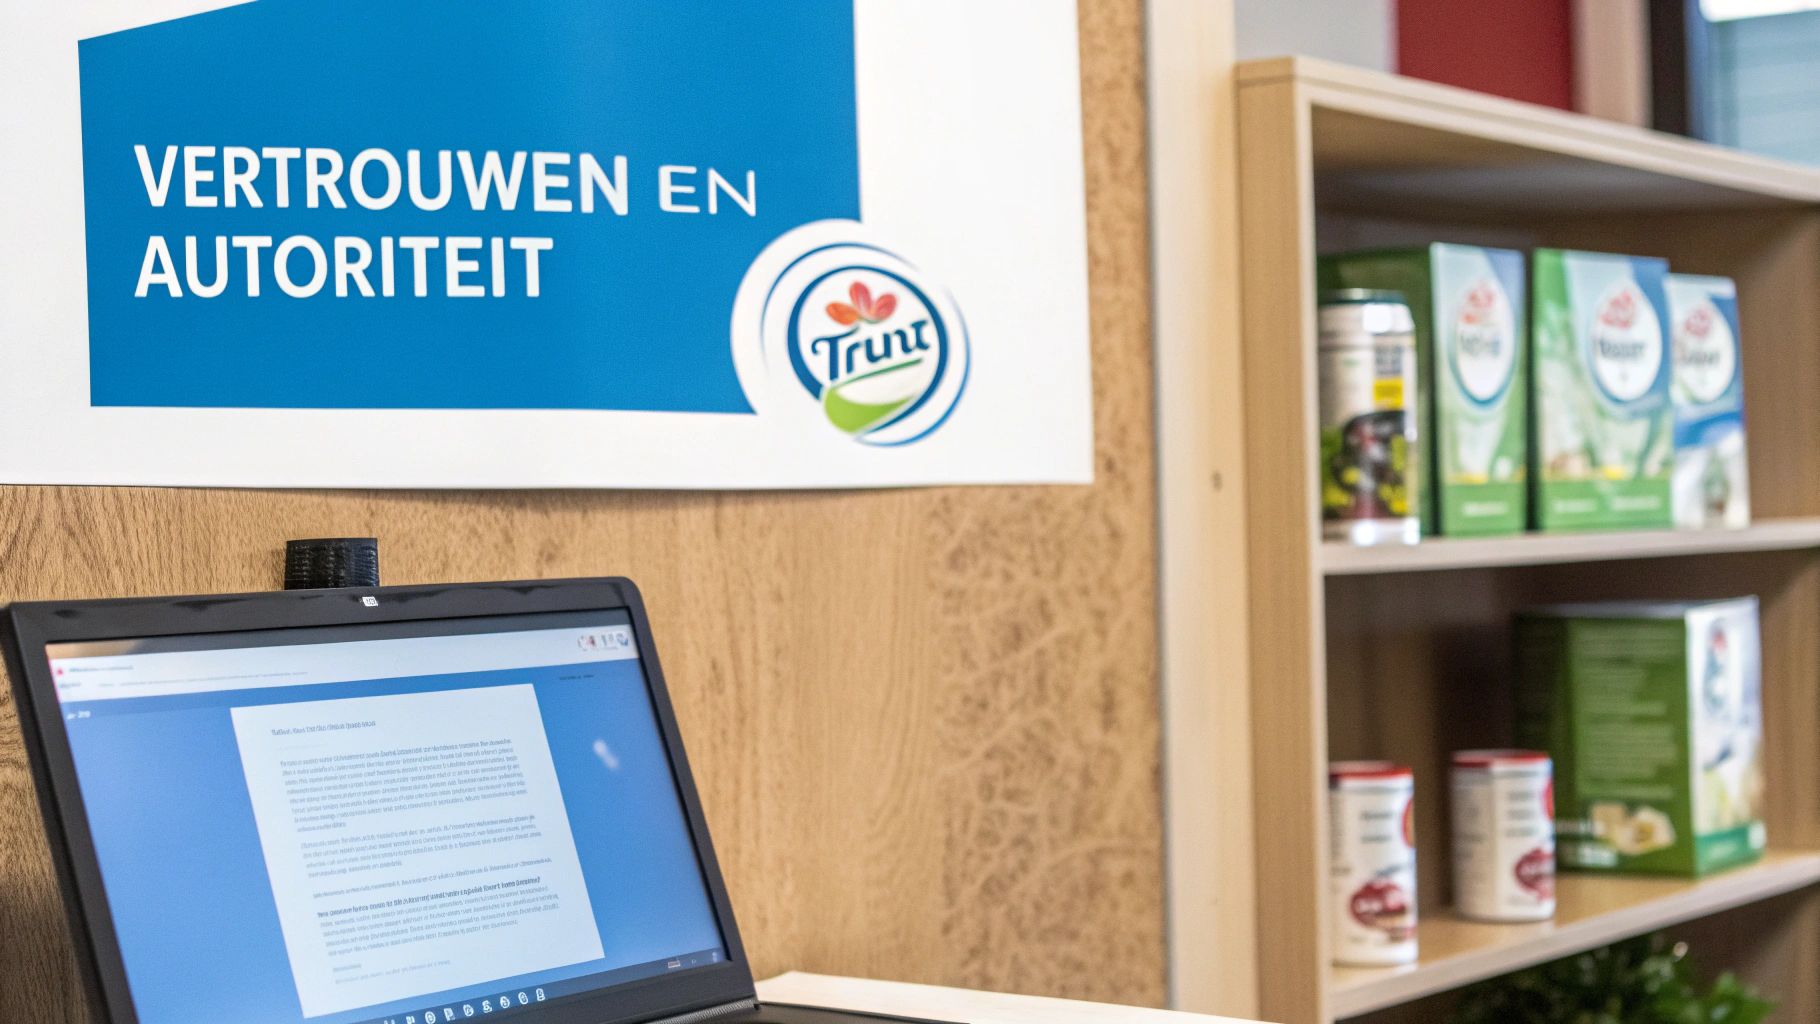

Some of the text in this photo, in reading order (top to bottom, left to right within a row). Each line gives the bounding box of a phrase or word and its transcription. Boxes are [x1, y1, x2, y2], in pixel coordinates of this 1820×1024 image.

[134, 144, 757, 217] VERTROUWEN EN
[135, 234, 554, 299] AUTORITEIT
